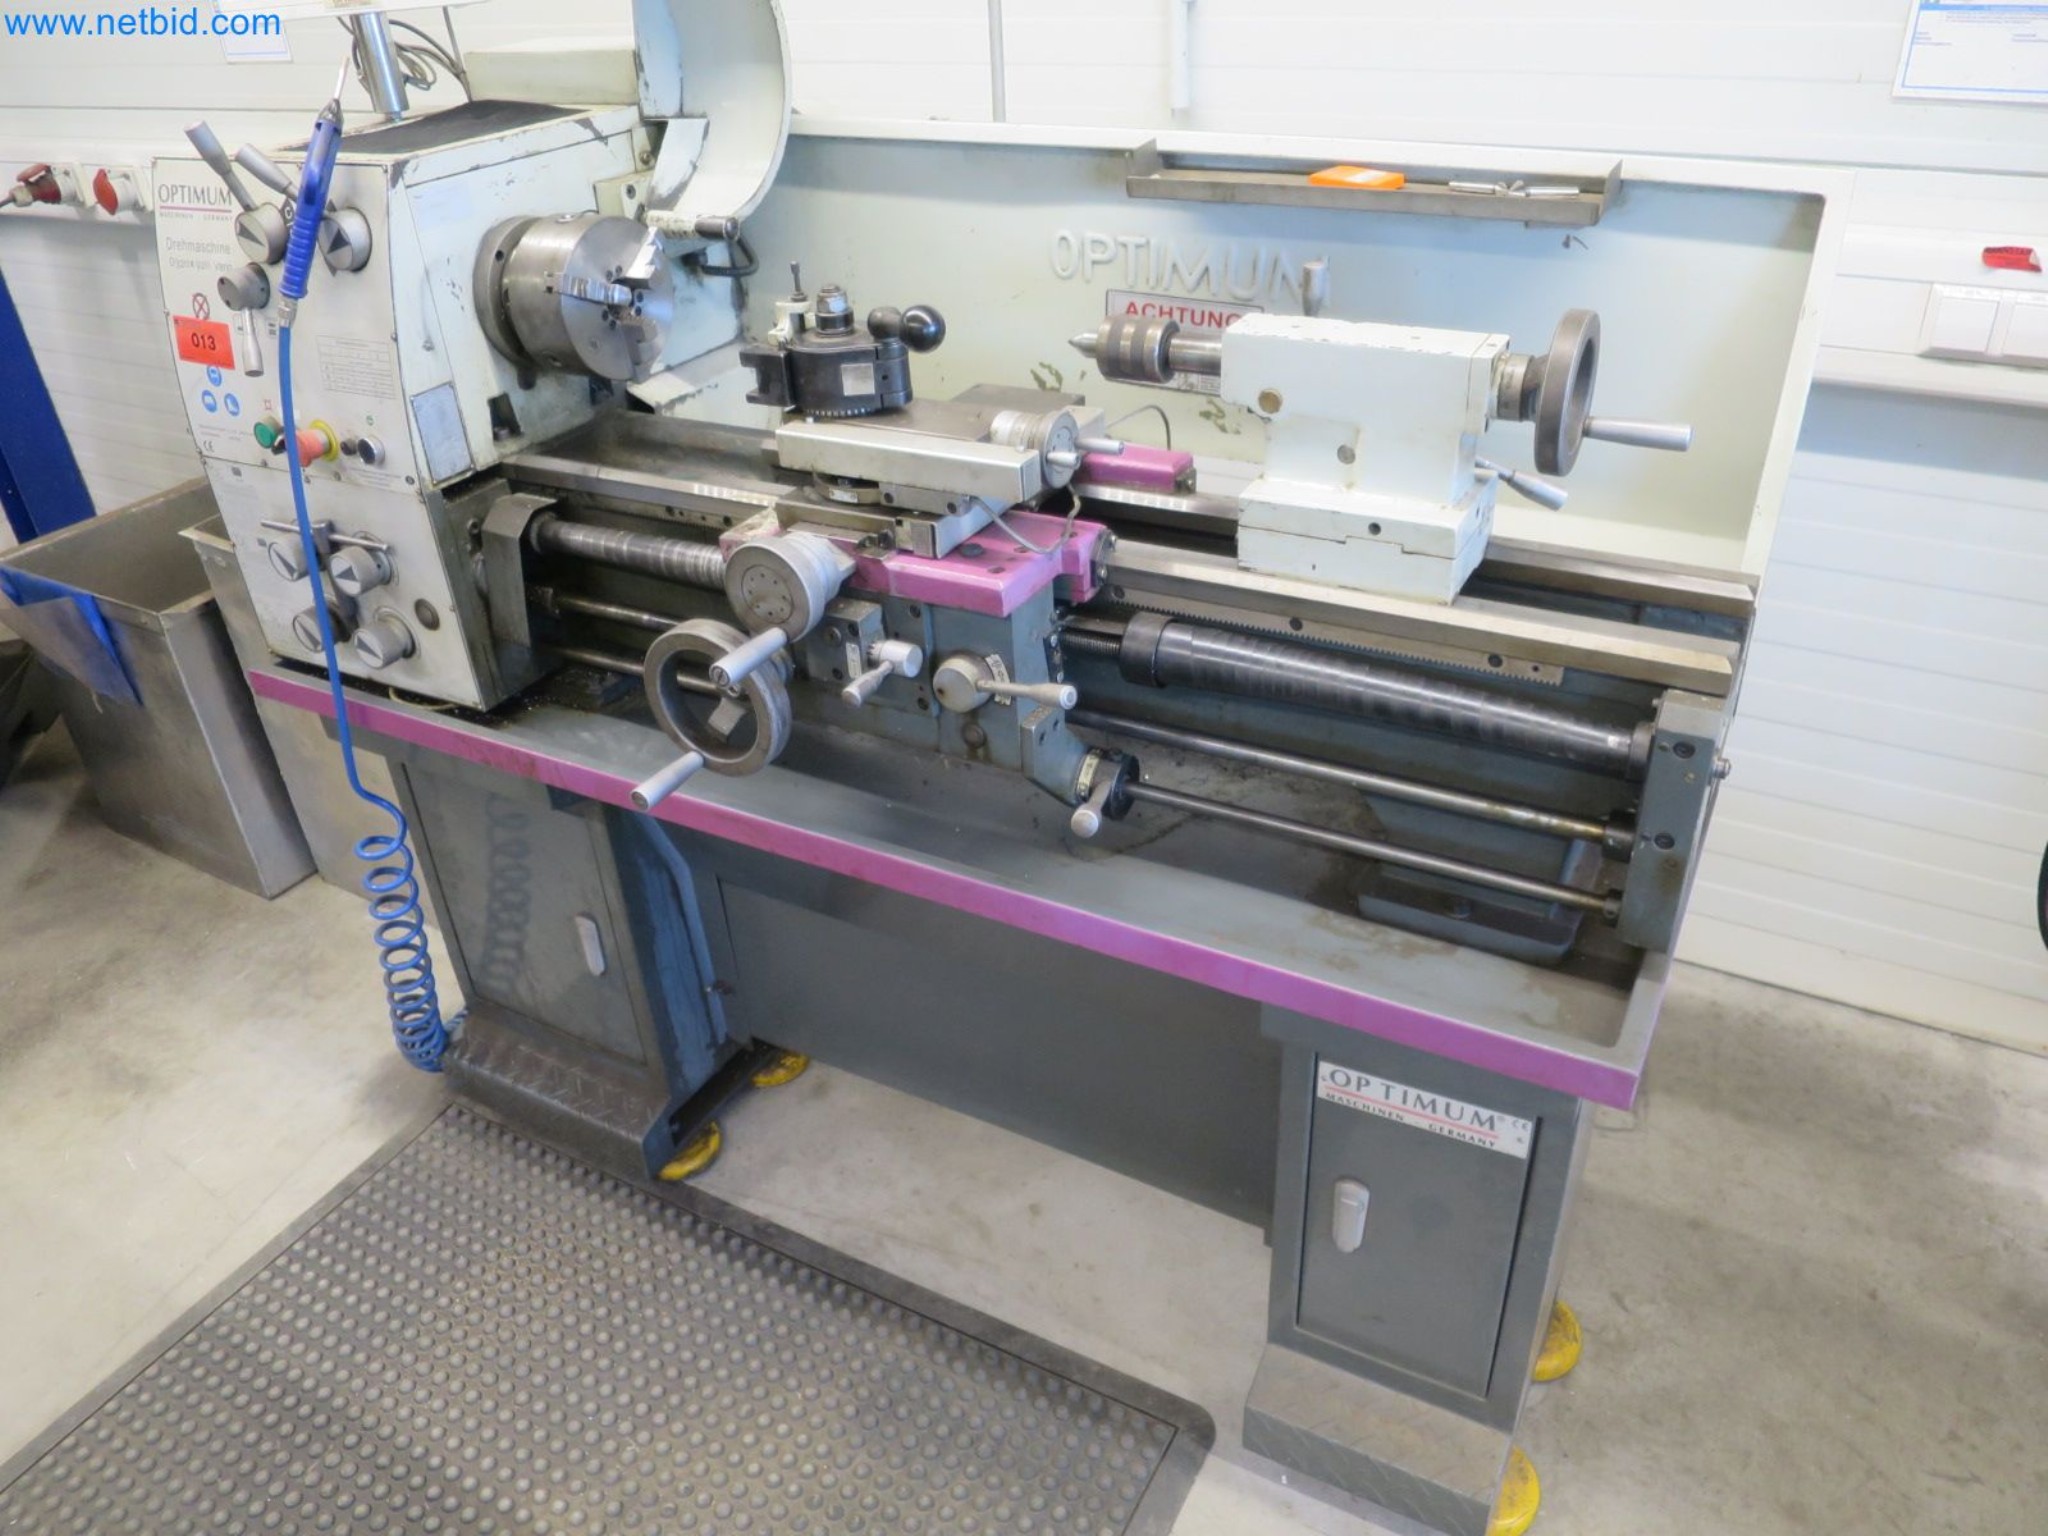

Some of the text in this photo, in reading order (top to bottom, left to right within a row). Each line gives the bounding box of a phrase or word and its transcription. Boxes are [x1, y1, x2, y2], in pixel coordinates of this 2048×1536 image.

[158, 183, 233, 206] OPTIMUM
[191, 332, 216, 351] 013
[1328, 1068, 1497, 1132] OPTIMUM
[1325, 1092, 1497, 1148] MASCHINEN GERMANY
